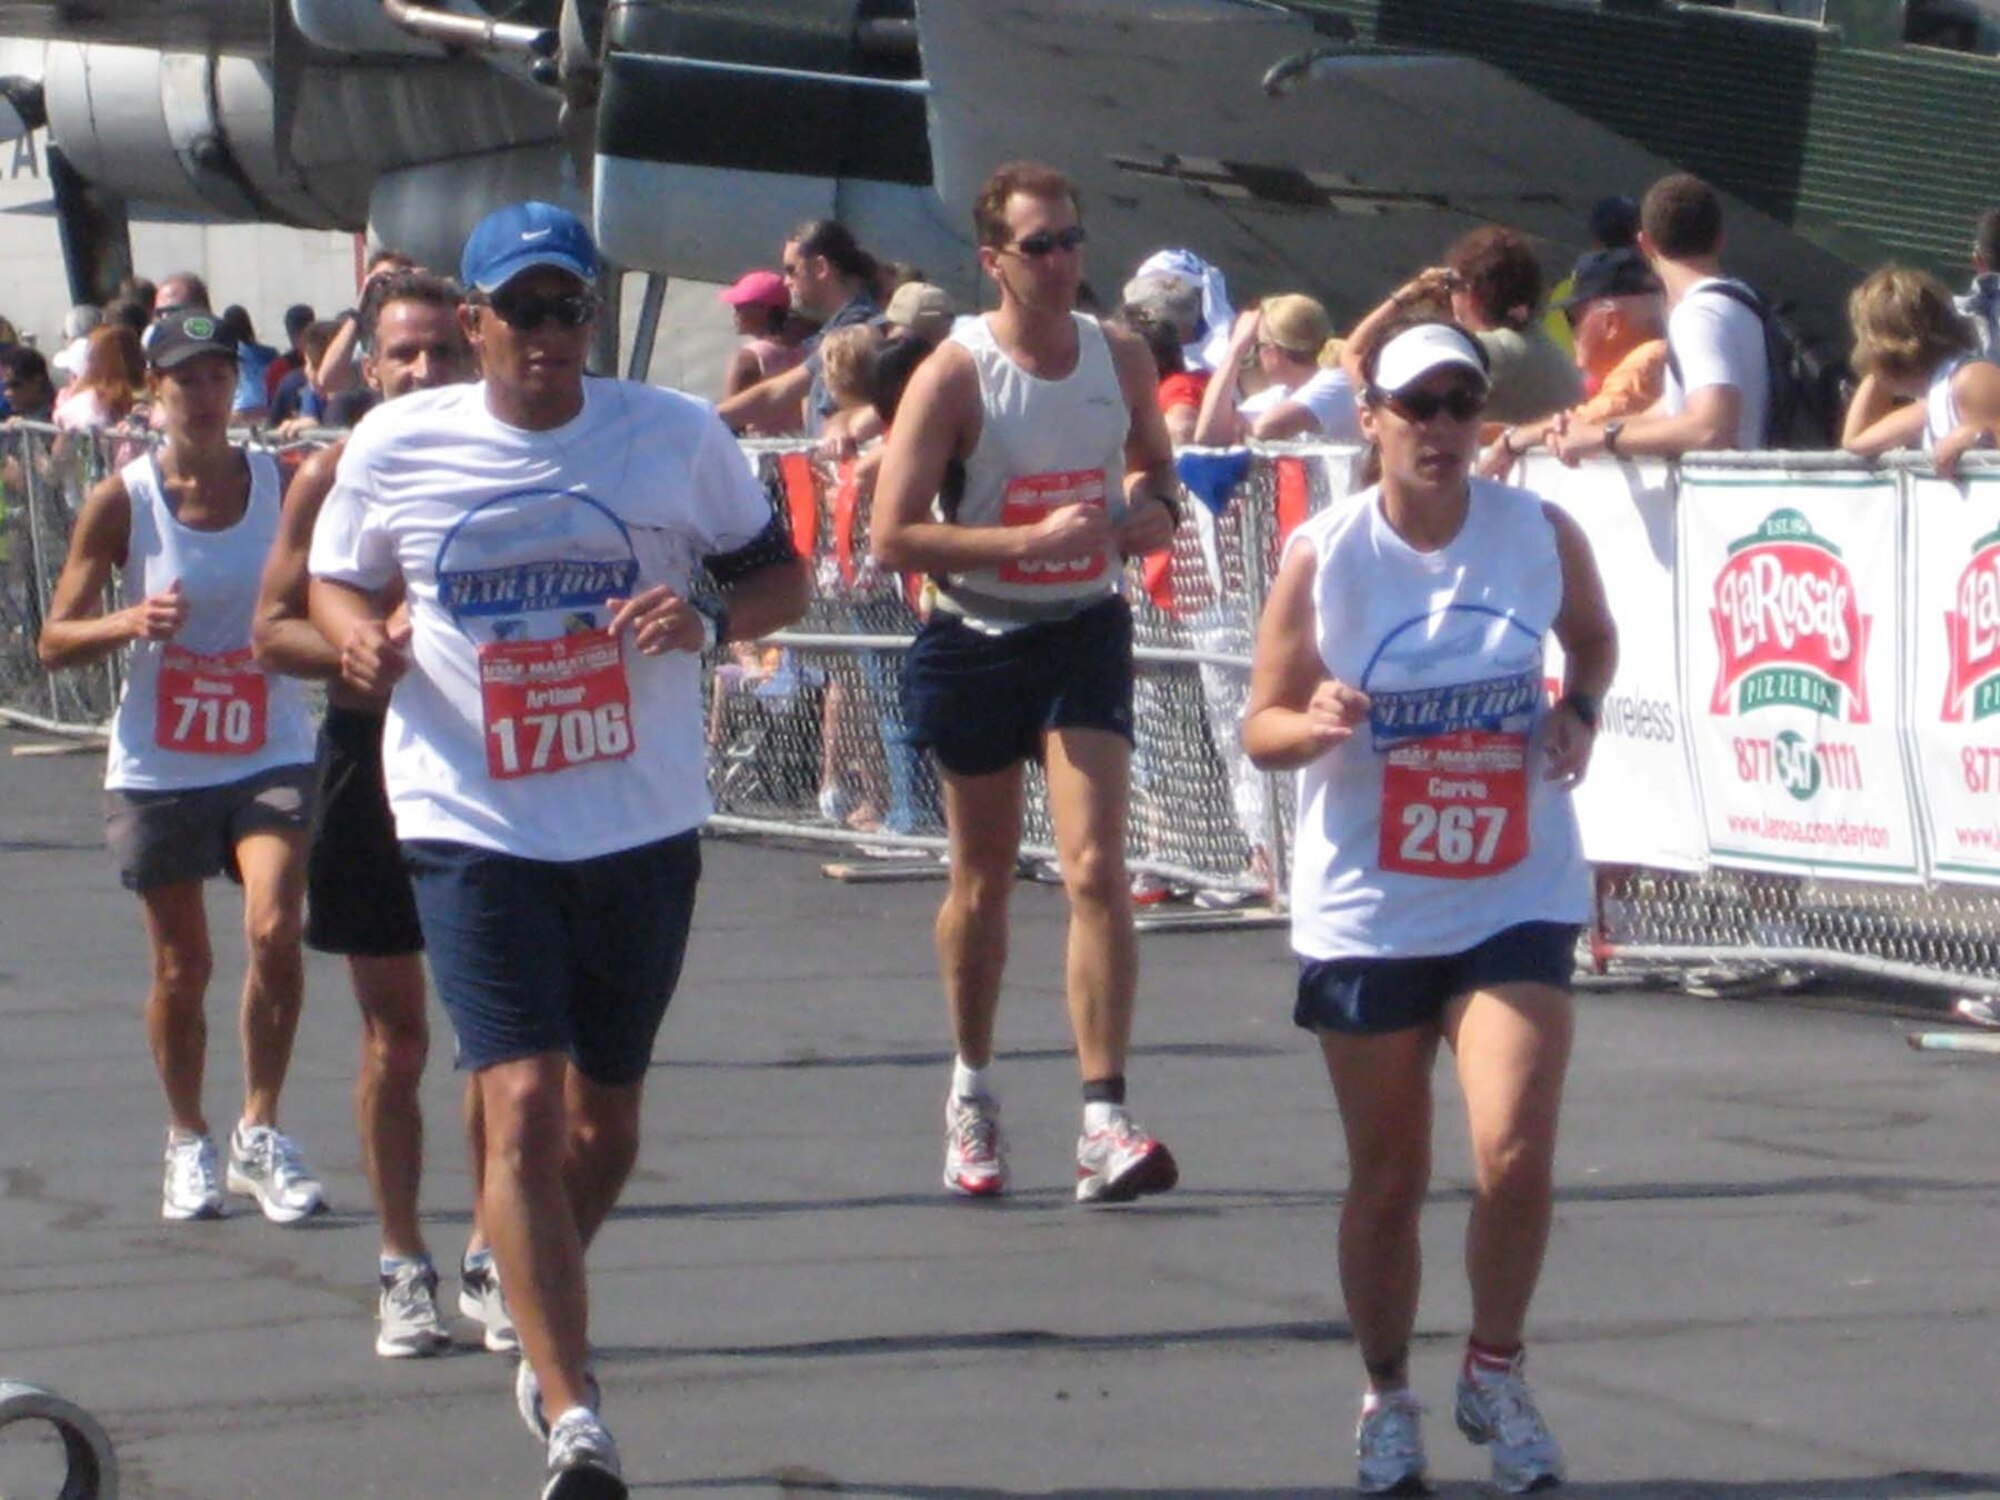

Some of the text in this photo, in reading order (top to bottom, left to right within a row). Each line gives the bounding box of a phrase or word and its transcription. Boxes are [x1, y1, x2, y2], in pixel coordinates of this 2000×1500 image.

[1719, 553, 1850, 661] LaRosa's
[1747, 673, 1833, 708] PIZZERIA
[172, 696, 252, 744] 710
[490, 702, 631, 773] 1706
[1733, 736, 1772, 785] 877
[1399, 803, 1509, 865] 267
